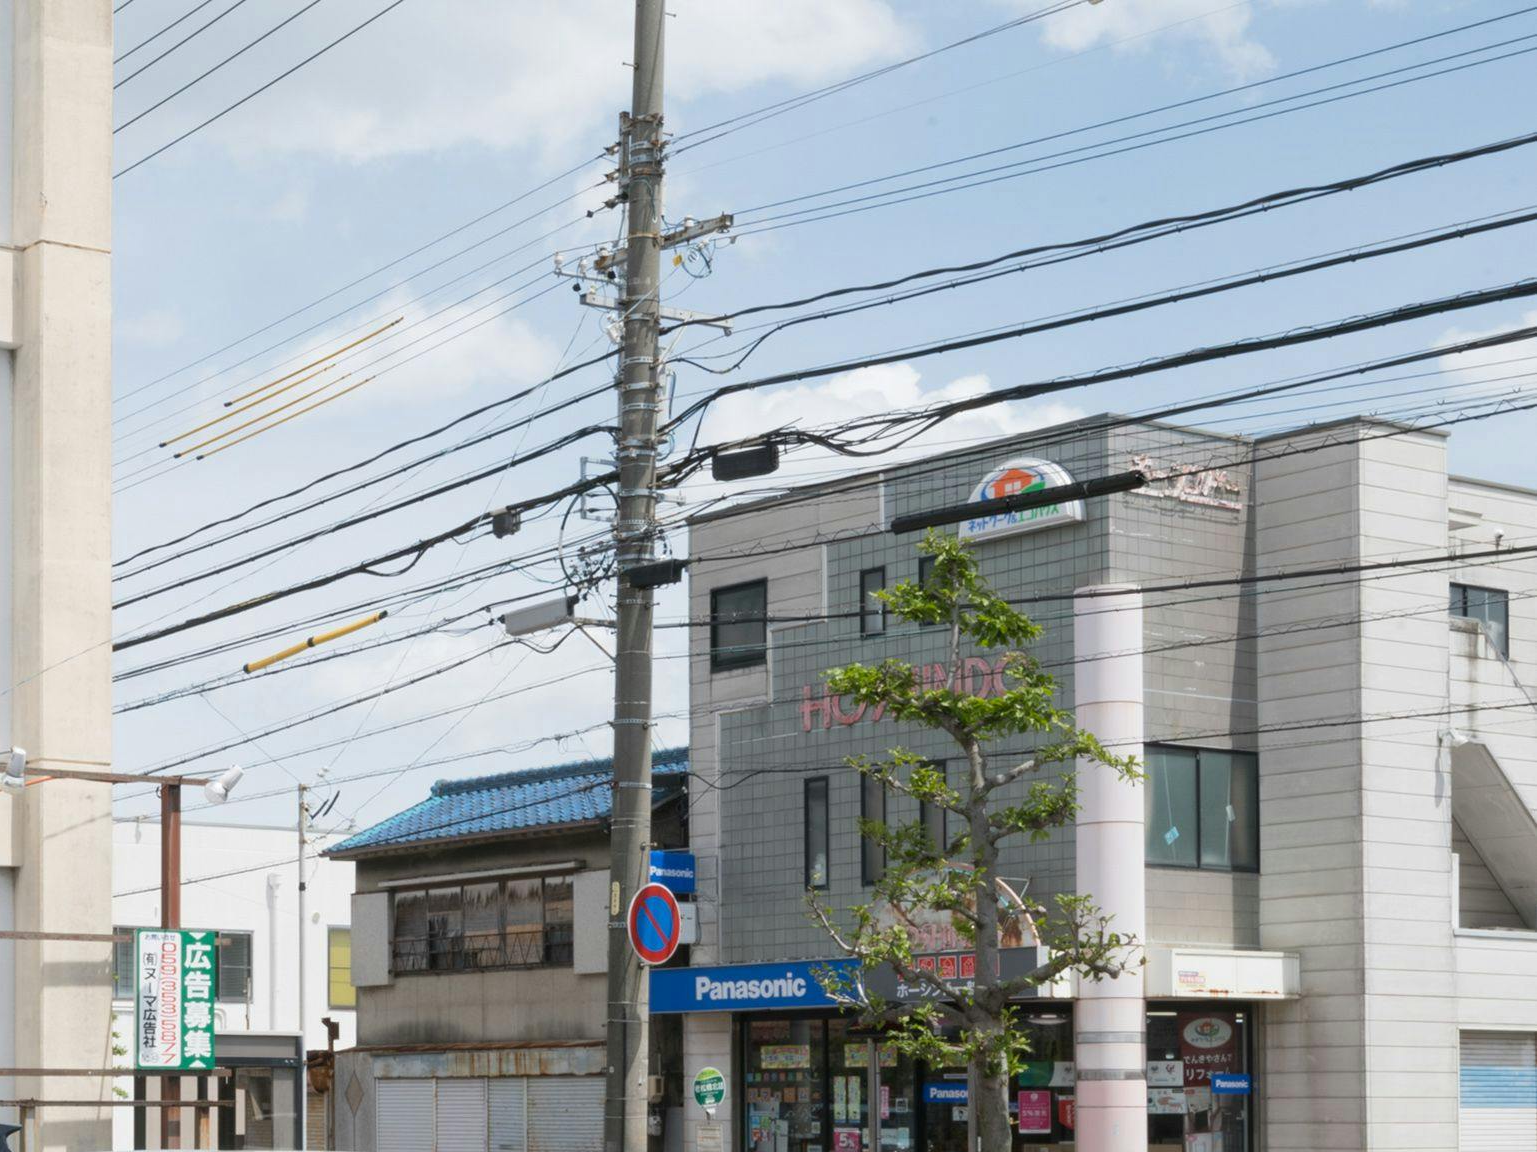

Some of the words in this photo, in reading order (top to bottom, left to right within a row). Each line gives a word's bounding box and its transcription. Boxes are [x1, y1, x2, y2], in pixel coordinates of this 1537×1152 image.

[649, 866, 694, 879] Panasonic
[695, 972, 807, 1001] Panasonic
[160, 942, 177, 1064] 059(353)5877
[184, 942, 211, 1058] 広告募集
[929, 1087, 969, 1099] Panaso
[1215, 1079, 1249, 1089] Panasonic
